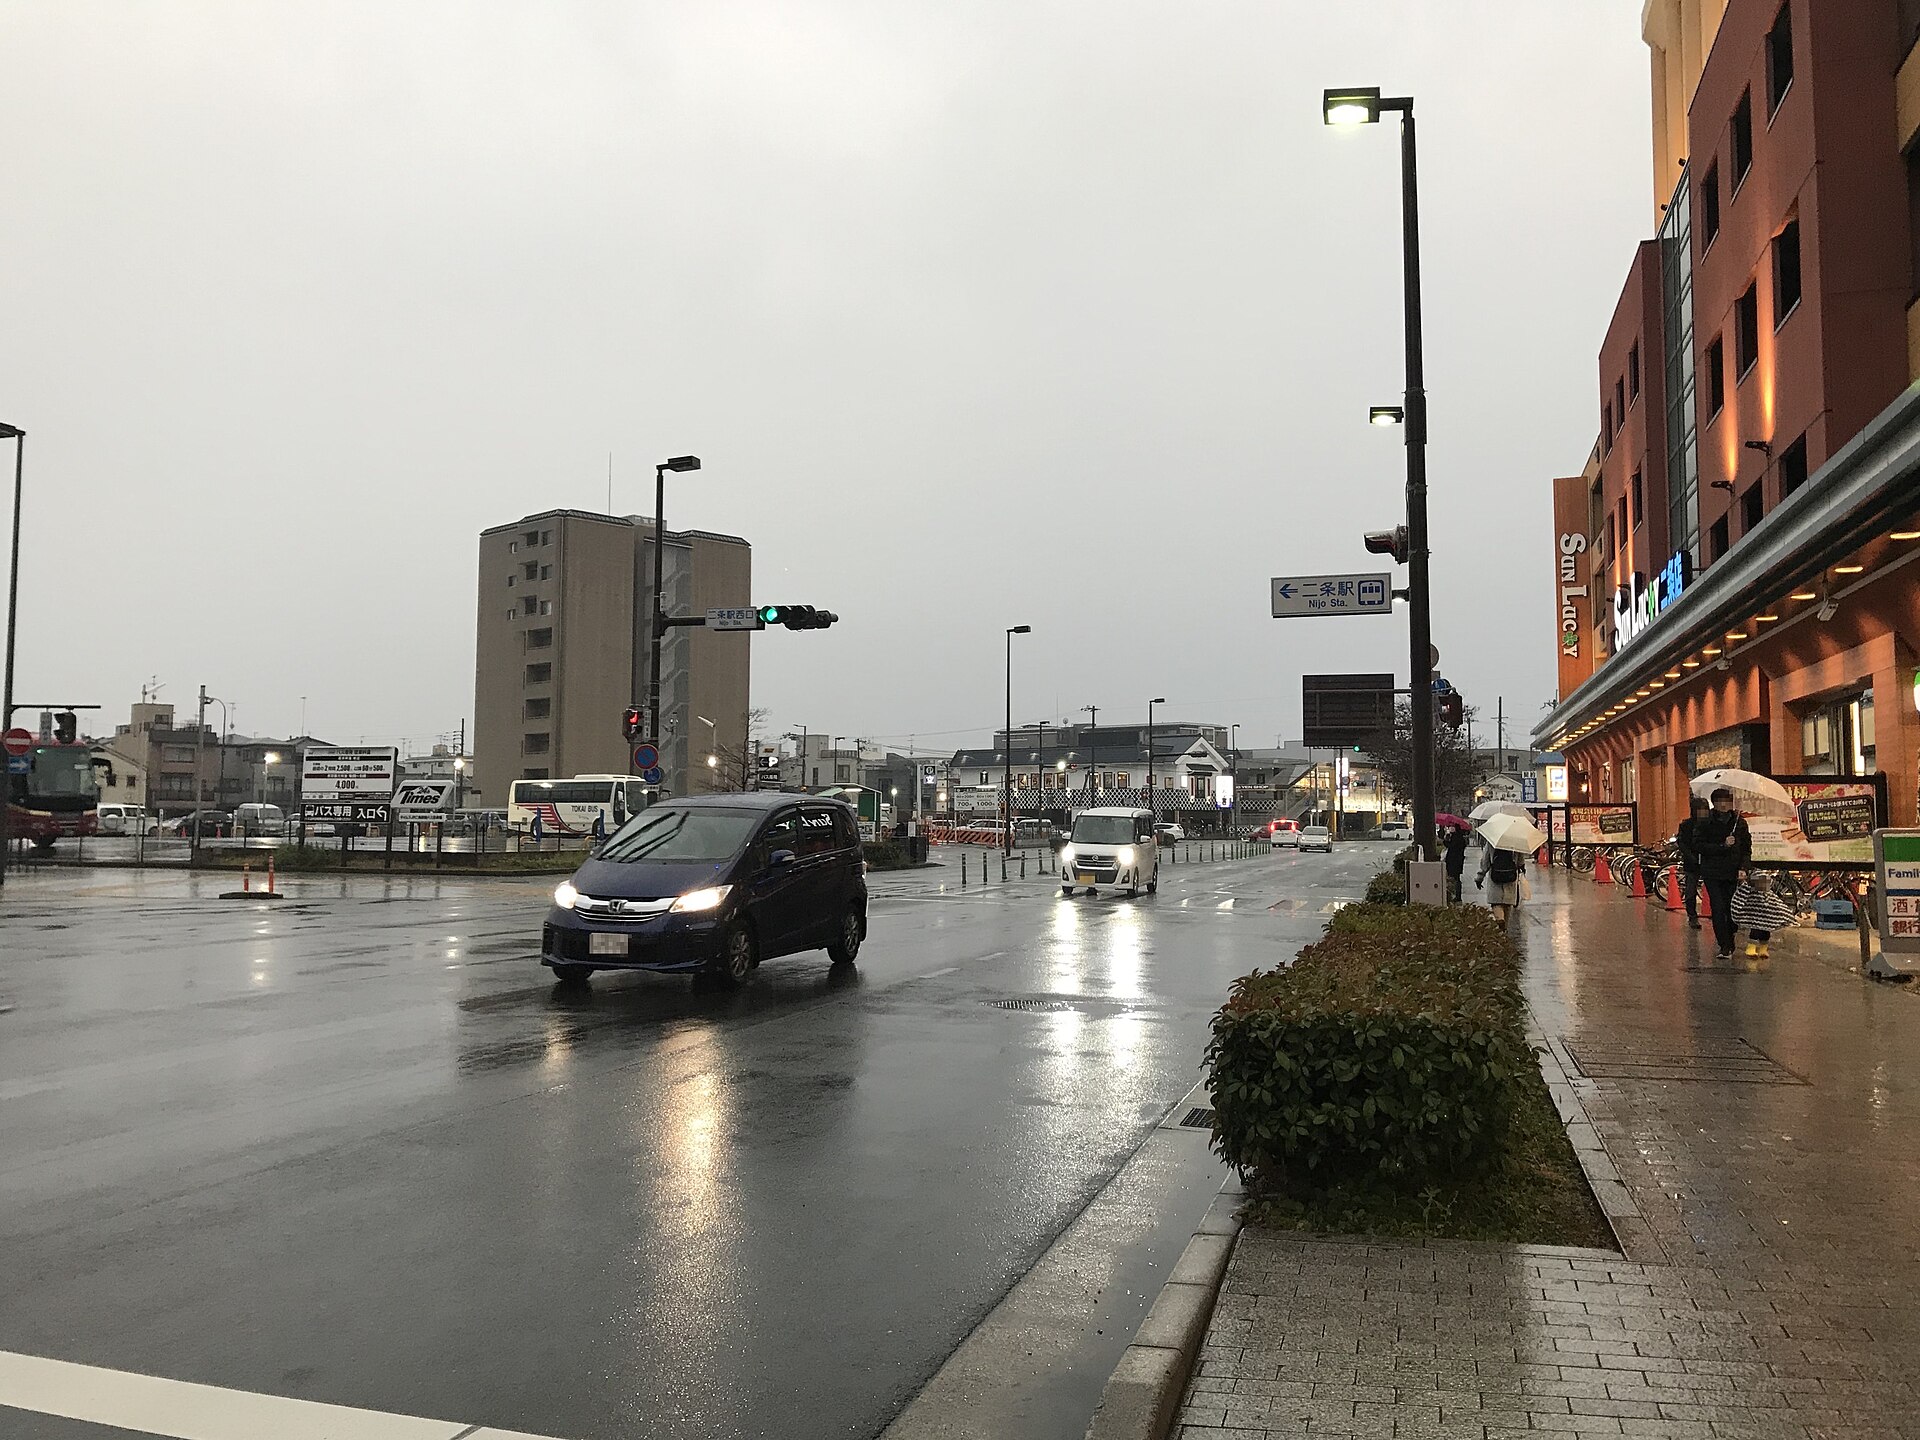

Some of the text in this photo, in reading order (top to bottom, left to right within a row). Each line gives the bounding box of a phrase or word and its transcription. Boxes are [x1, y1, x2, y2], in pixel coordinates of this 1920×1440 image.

[1302, 581, 1354, 597] 二条駅
[1308, 598, 1347, 609] Nijo Sta.
[708, 610, 754, 620] 二条駅西口
[399, 791, 441, 805] Times
[314, 805, 376, 819] バス専用 入口
[587, 805, 599, 813] BUS
